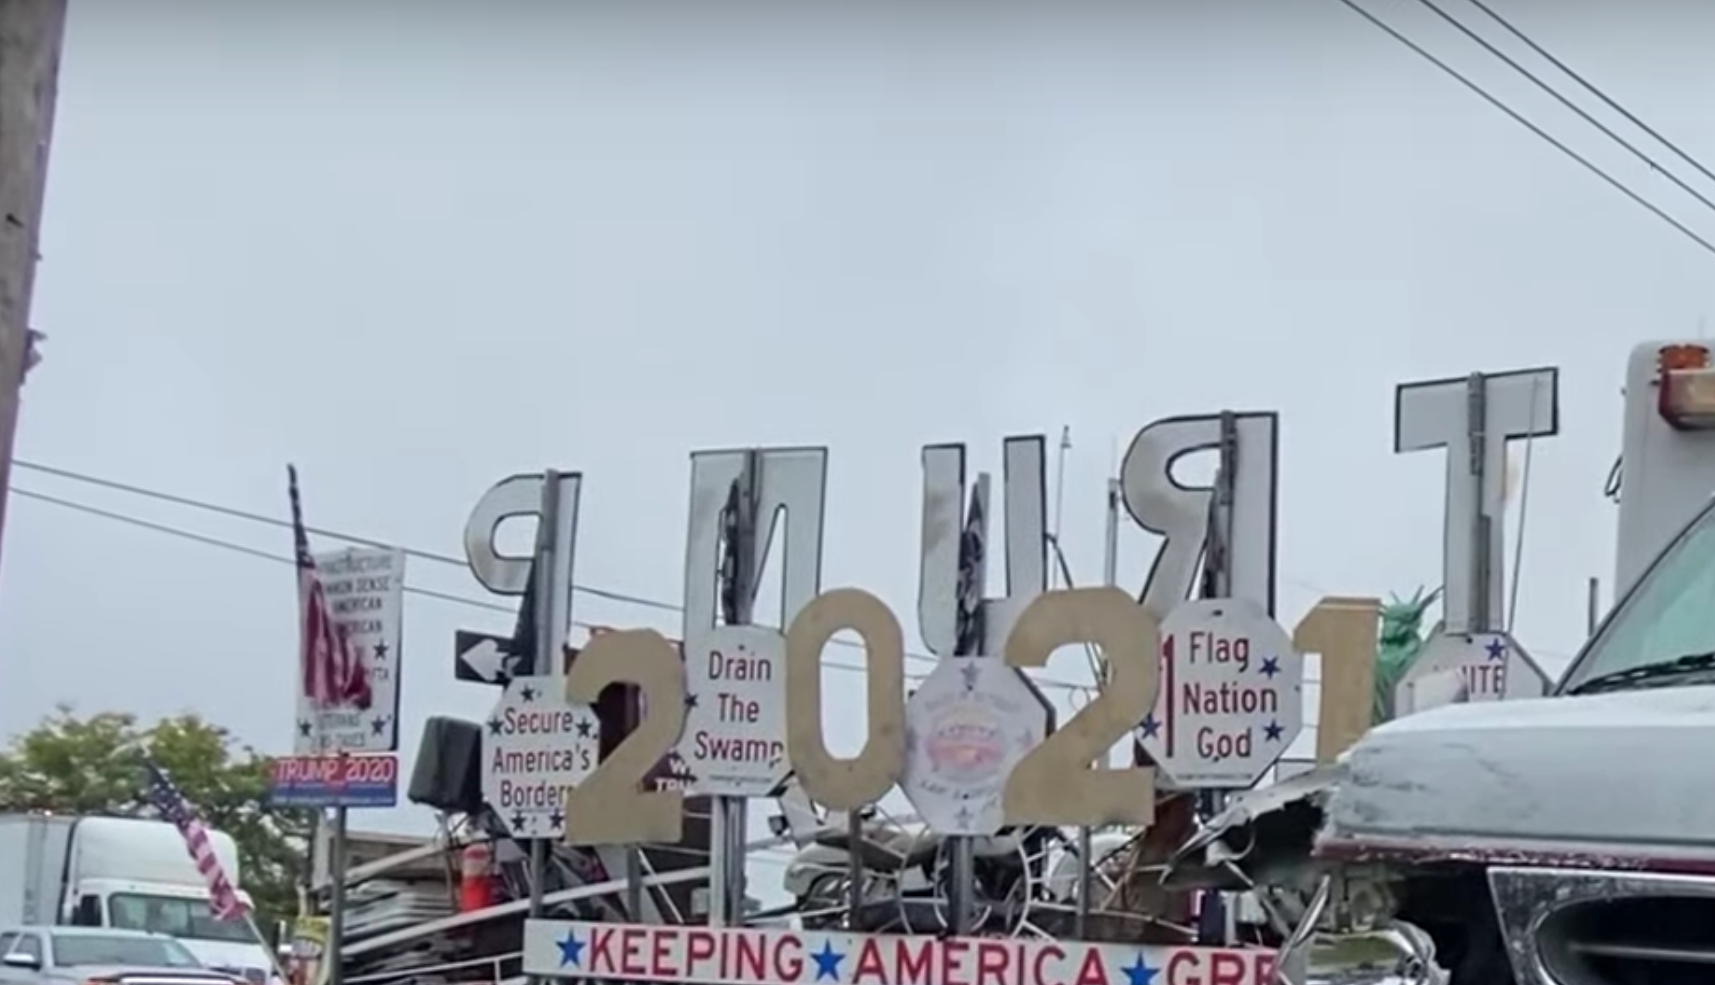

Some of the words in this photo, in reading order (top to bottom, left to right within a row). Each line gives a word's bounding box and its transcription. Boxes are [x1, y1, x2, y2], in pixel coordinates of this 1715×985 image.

[707, 649, 772, 682] Drain
[1189, 631, 1249, 673] Flag
[717, 692, 760, 723] The
[1182, 681, 1278, 715] Nation
[503, 706, 574, 735] Secure
[1196, 725, 1253, 759] God
[278, 758, 339, 781] TRUMP
[345, 758, 396, 781] 2020
[492, 744, 591, 775] America's
[588, 927, 804, 983] KEEPING
